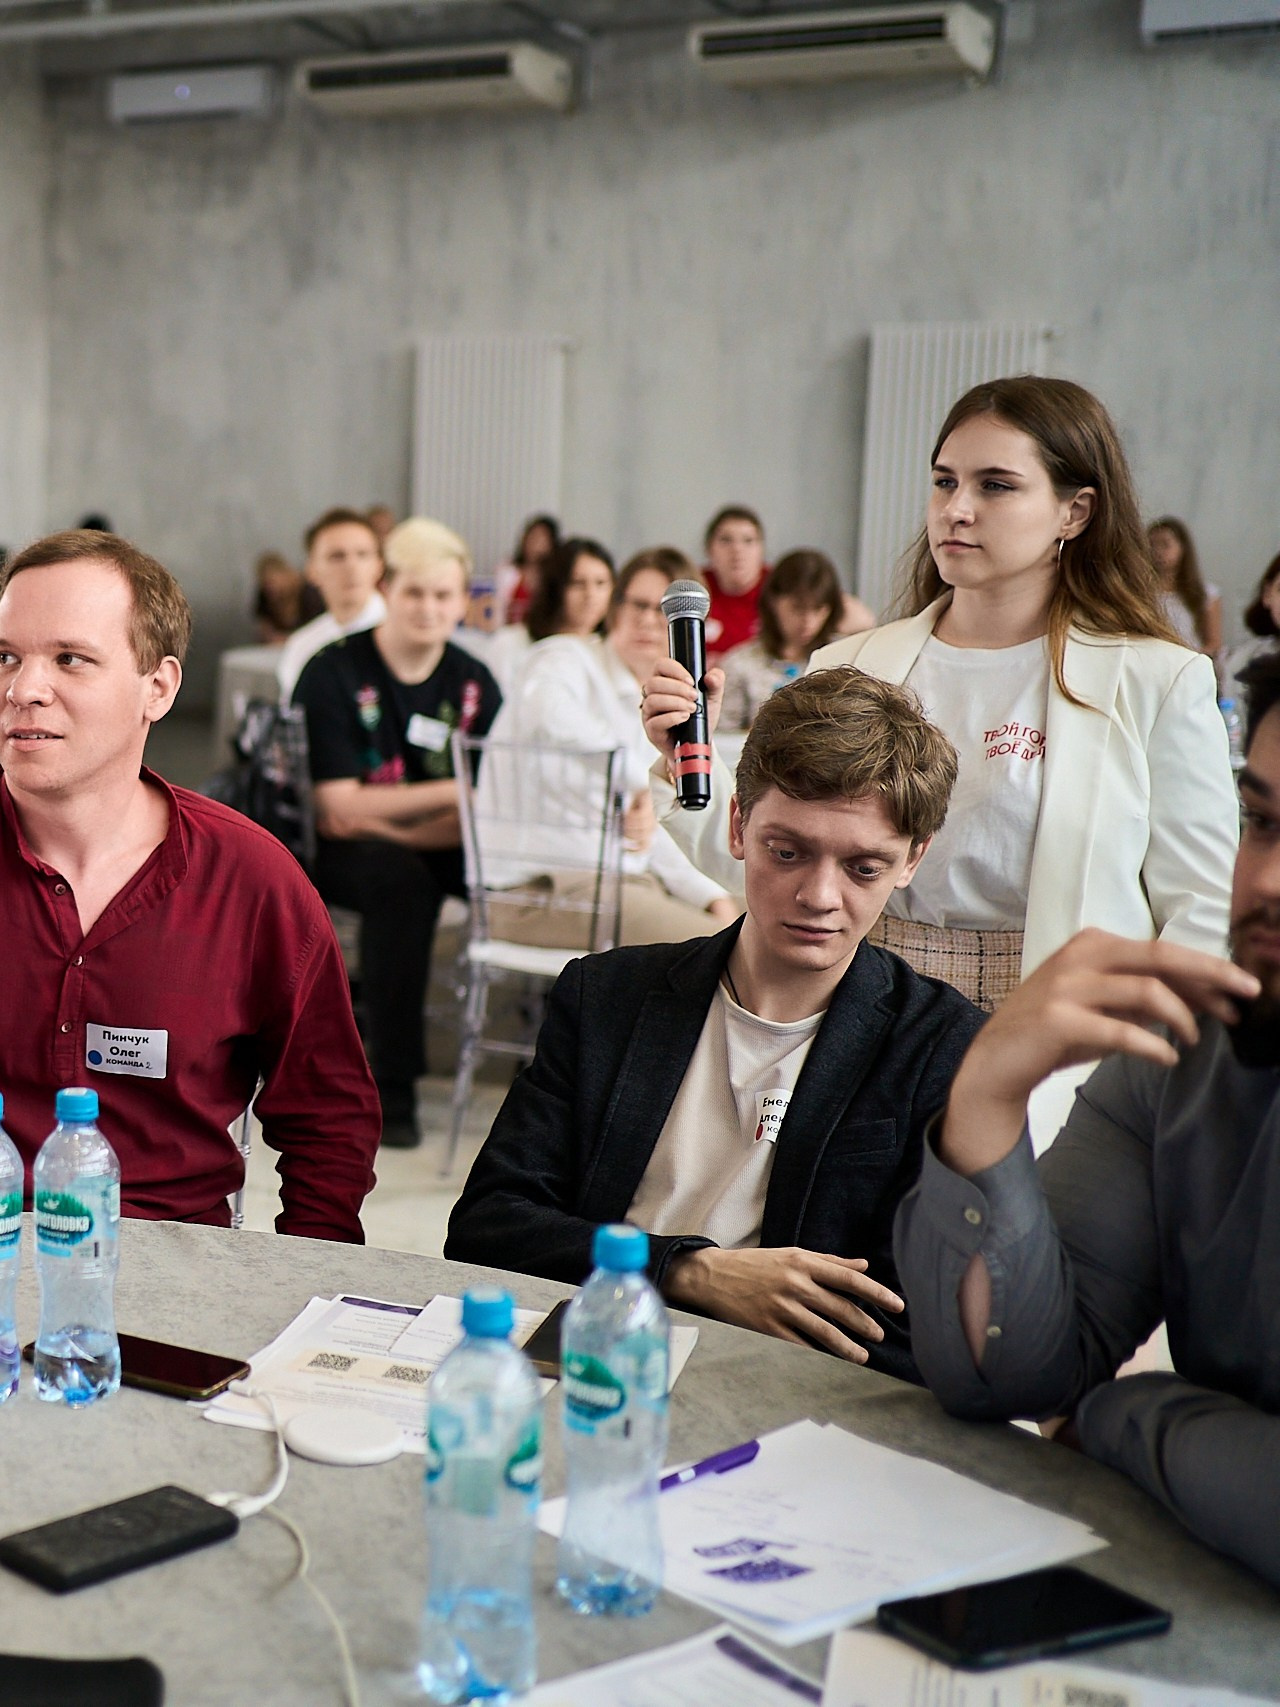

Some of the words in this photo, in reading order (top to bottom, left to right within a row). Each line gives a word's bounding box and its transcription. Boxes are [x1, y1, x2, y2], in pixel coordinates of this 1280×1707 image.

[984, 722, 1019, 743] ТВОЙ
[985, 741, 1021, 760] ТВОЁ
[102, 1030, 149, 1046] Пинчук
[109, 1046, 141, 1058] Олег
[106, 1058, 144, 1068] КОМАНДА
